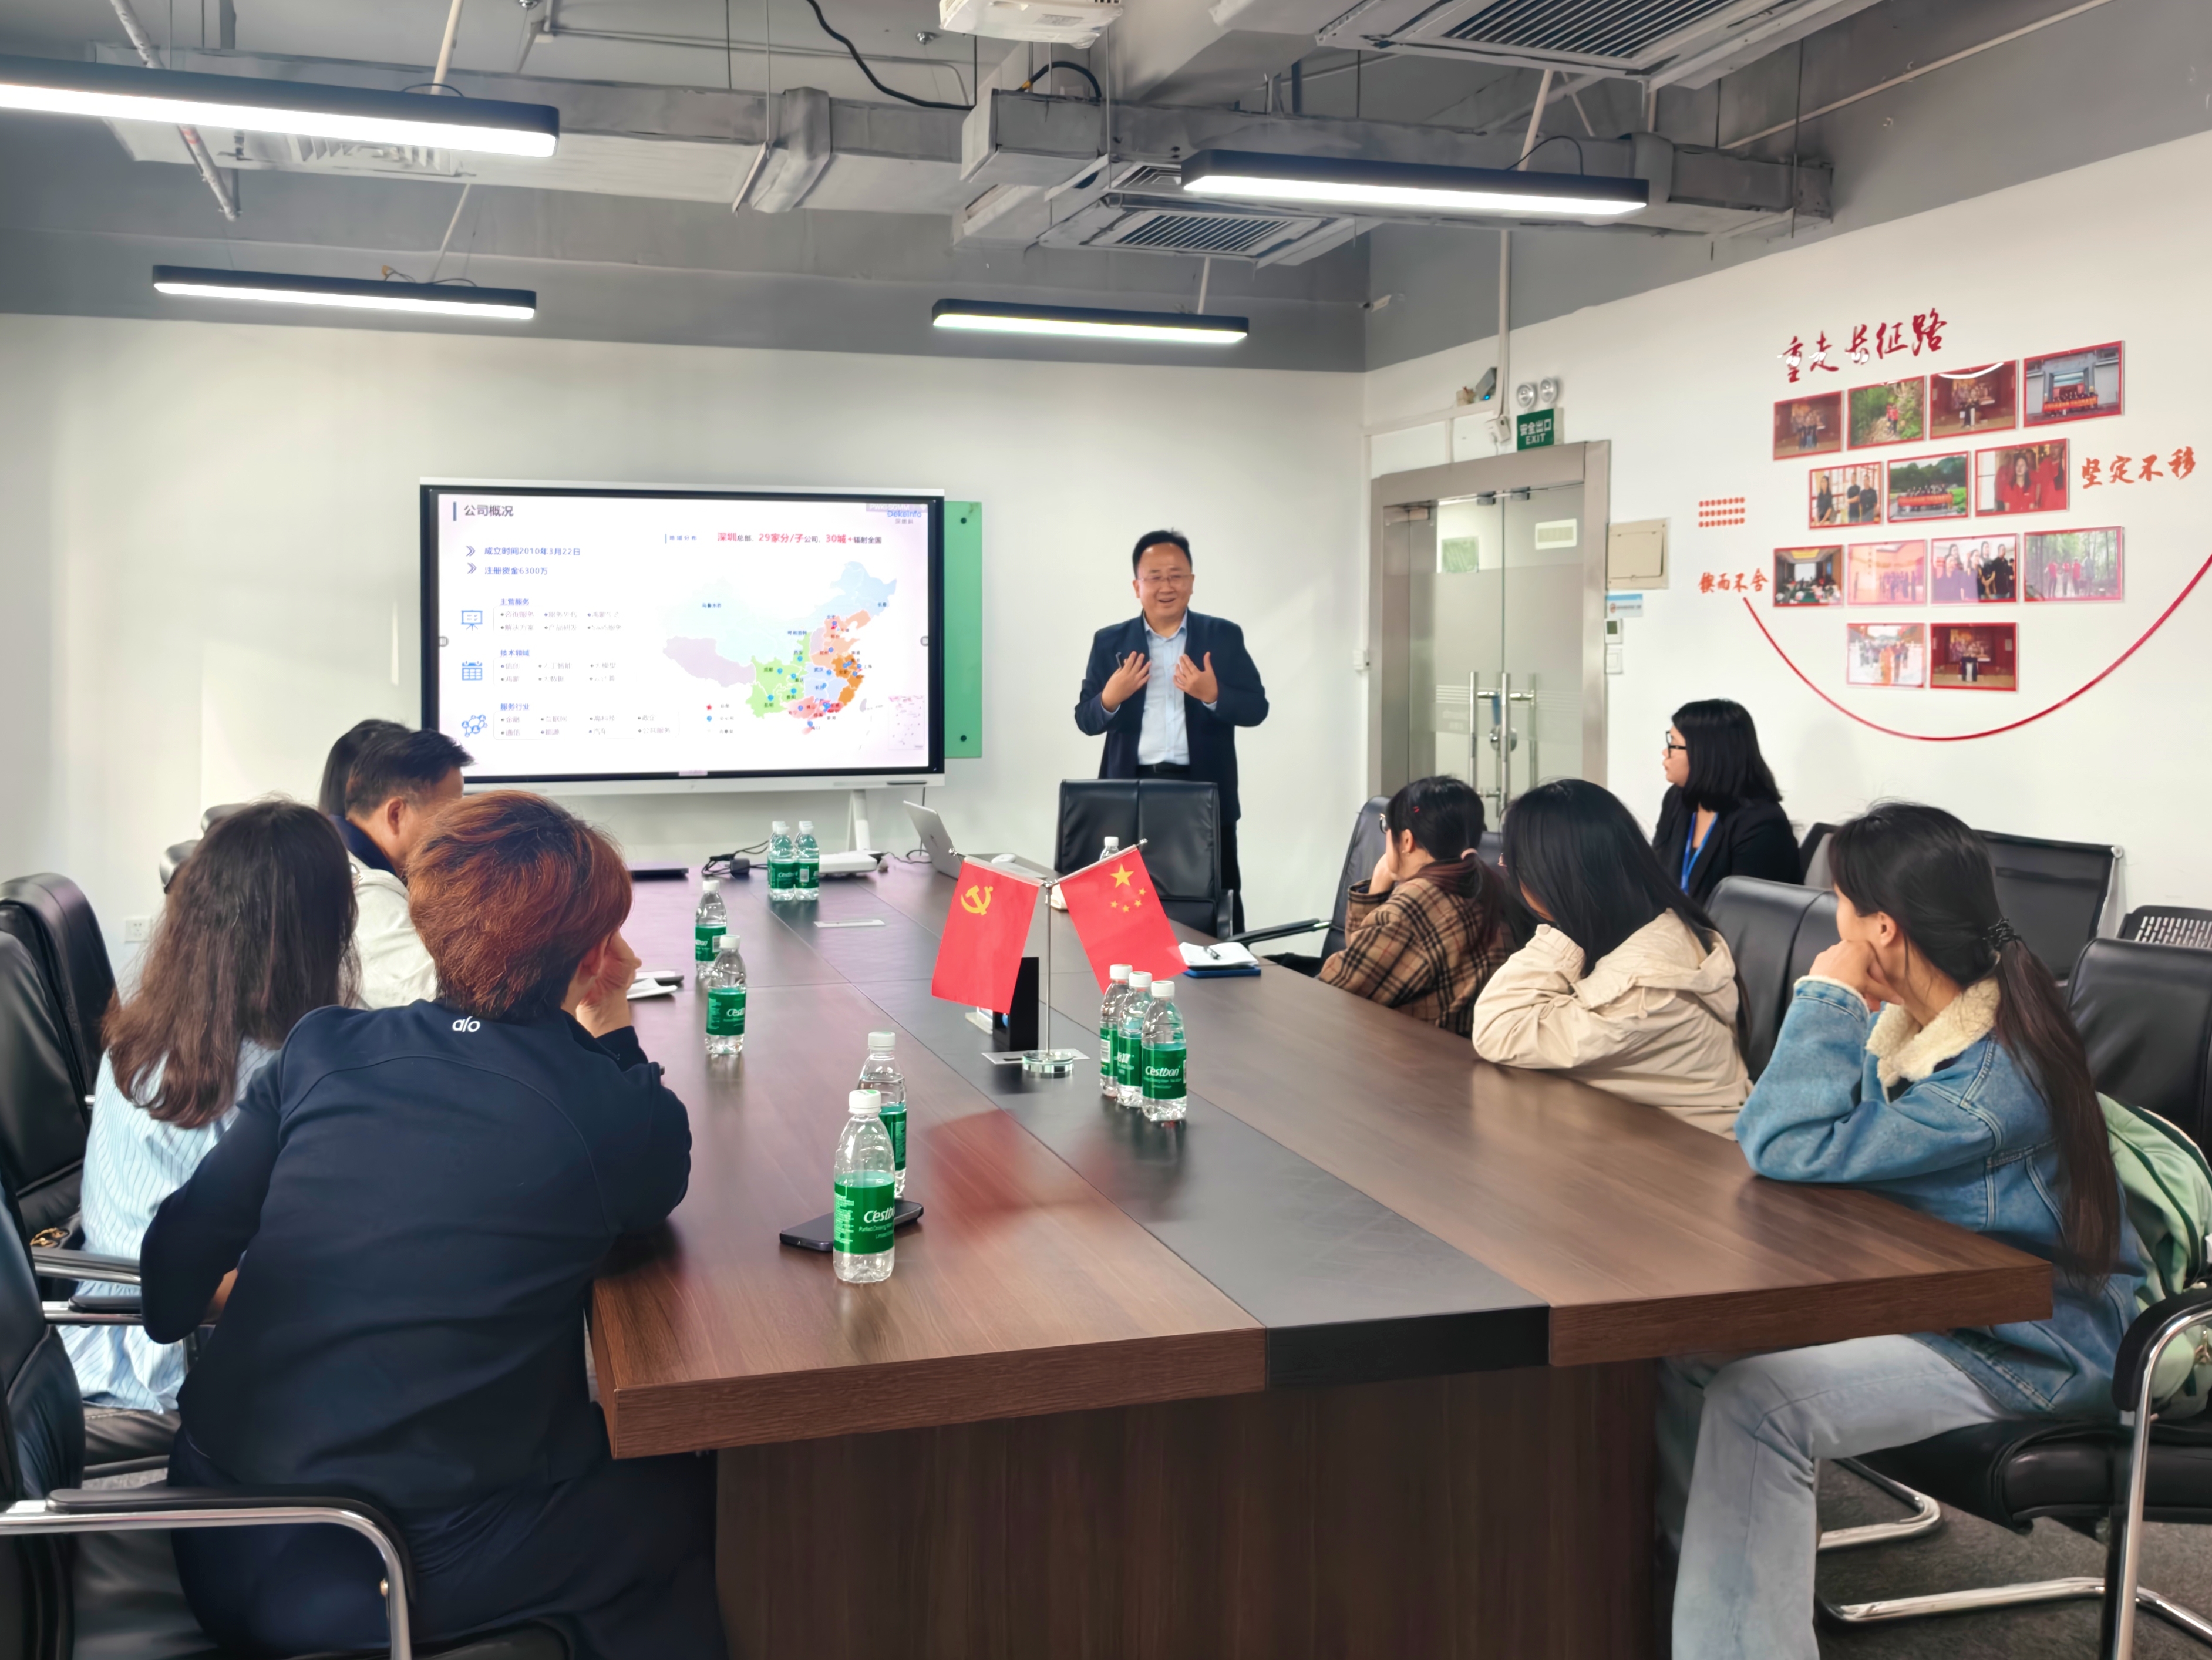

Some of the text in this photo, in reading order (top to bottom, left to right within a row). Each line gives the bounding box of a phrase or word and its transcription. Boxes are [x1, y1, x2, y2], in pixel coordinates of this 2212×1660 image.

[1777, 307, 1948, 383] 重走长征路
[1519, 418, 1552, 436] 安全出口
[1526, 433, 1546, 445] EXIT
[2081, 446, 2196, 489] 坚定不移
[464, 504, 514, 517] 公司概况
[484, 547, 581, 557] 成立时间2010年3月22日
[452, 1016, 481, 1032] alo
